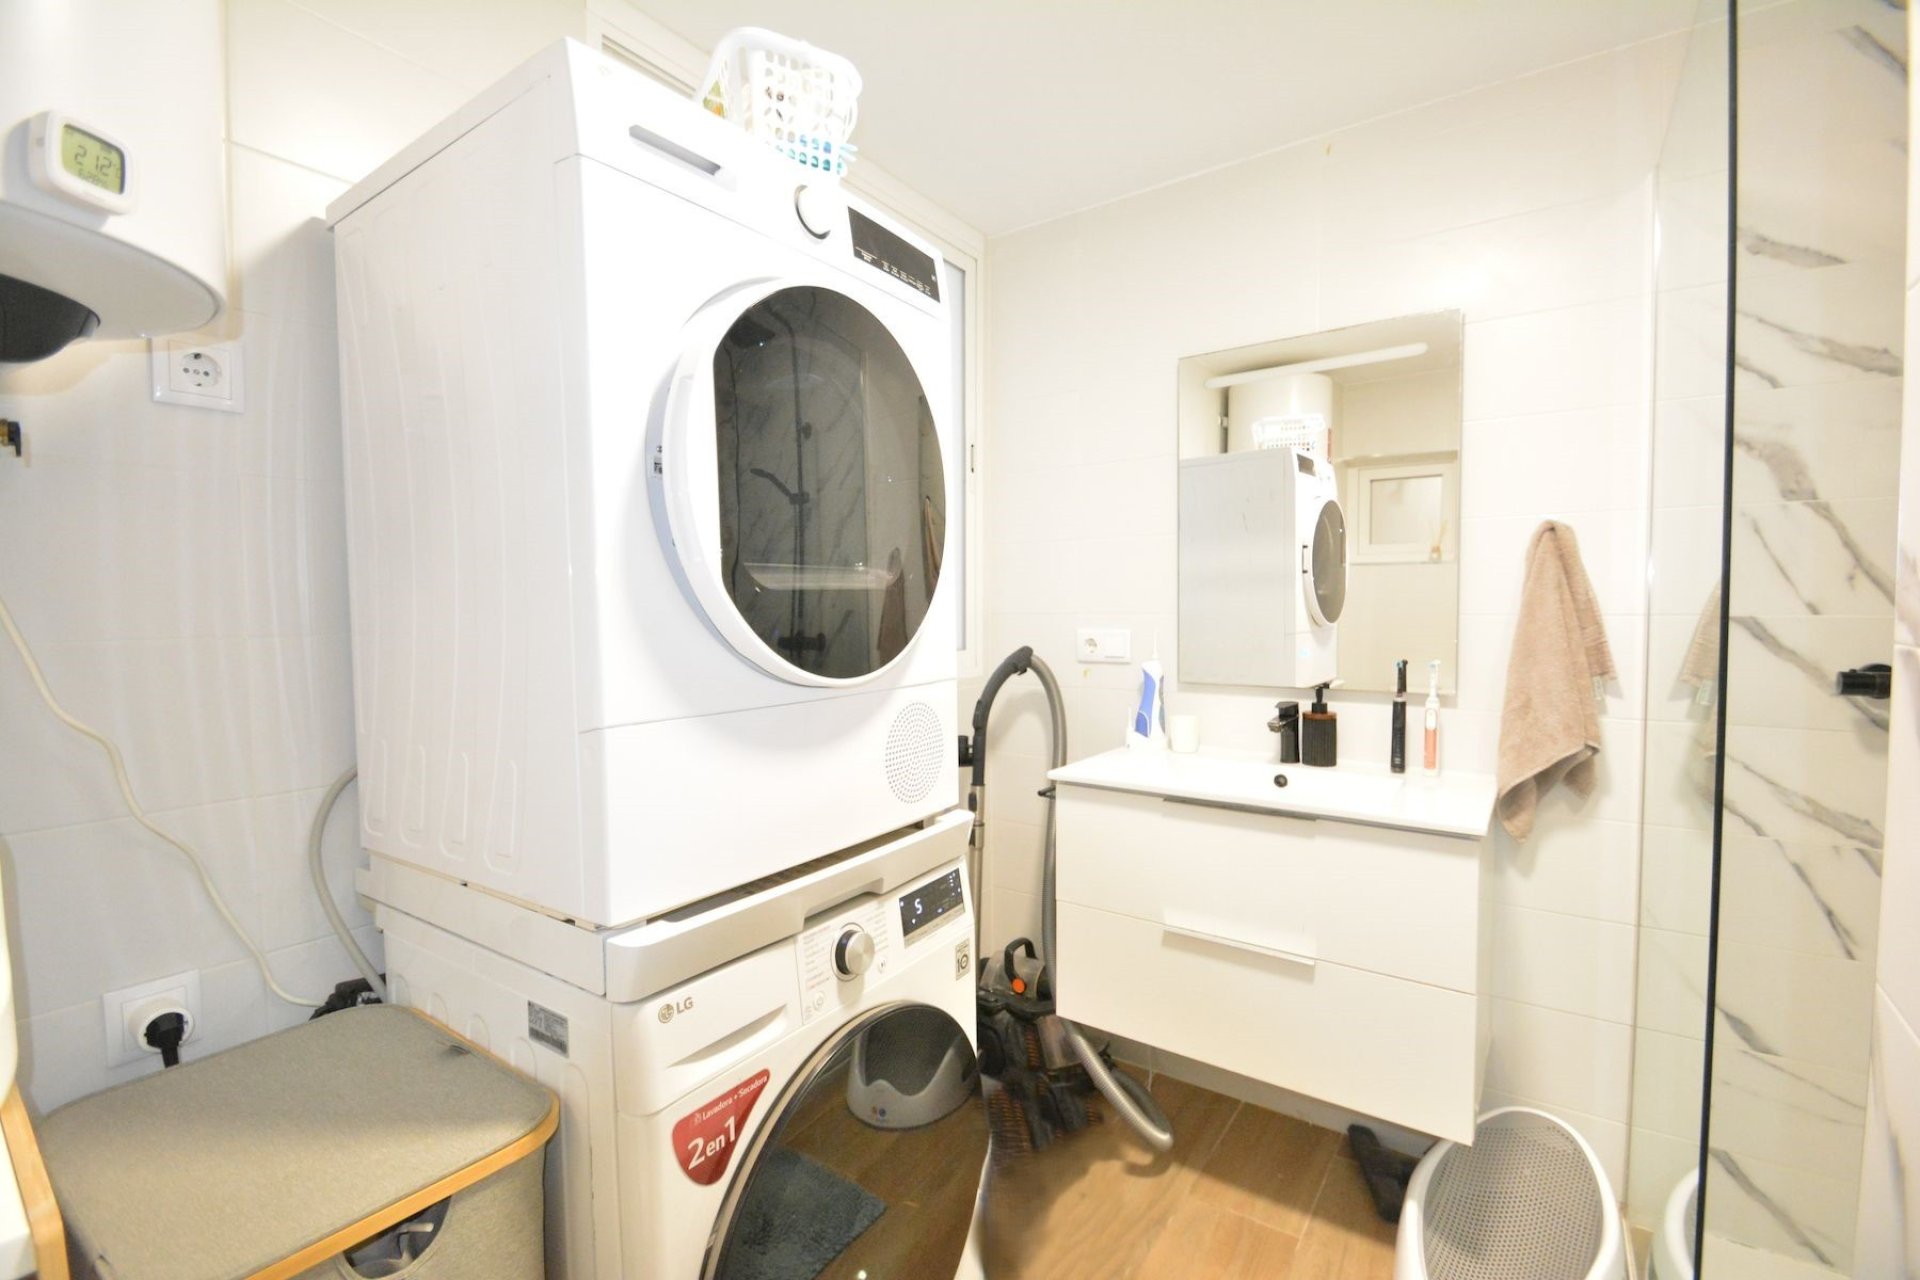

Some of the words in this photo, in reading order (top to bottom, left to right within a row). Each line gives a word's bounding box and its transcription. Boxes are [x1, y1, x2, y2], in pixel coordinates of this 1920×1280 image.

[676, 996, 694, 1014] LG
[702, 1096, 733, 1120] Lavadora
[738, 1075, 768, 1098] Secadora
